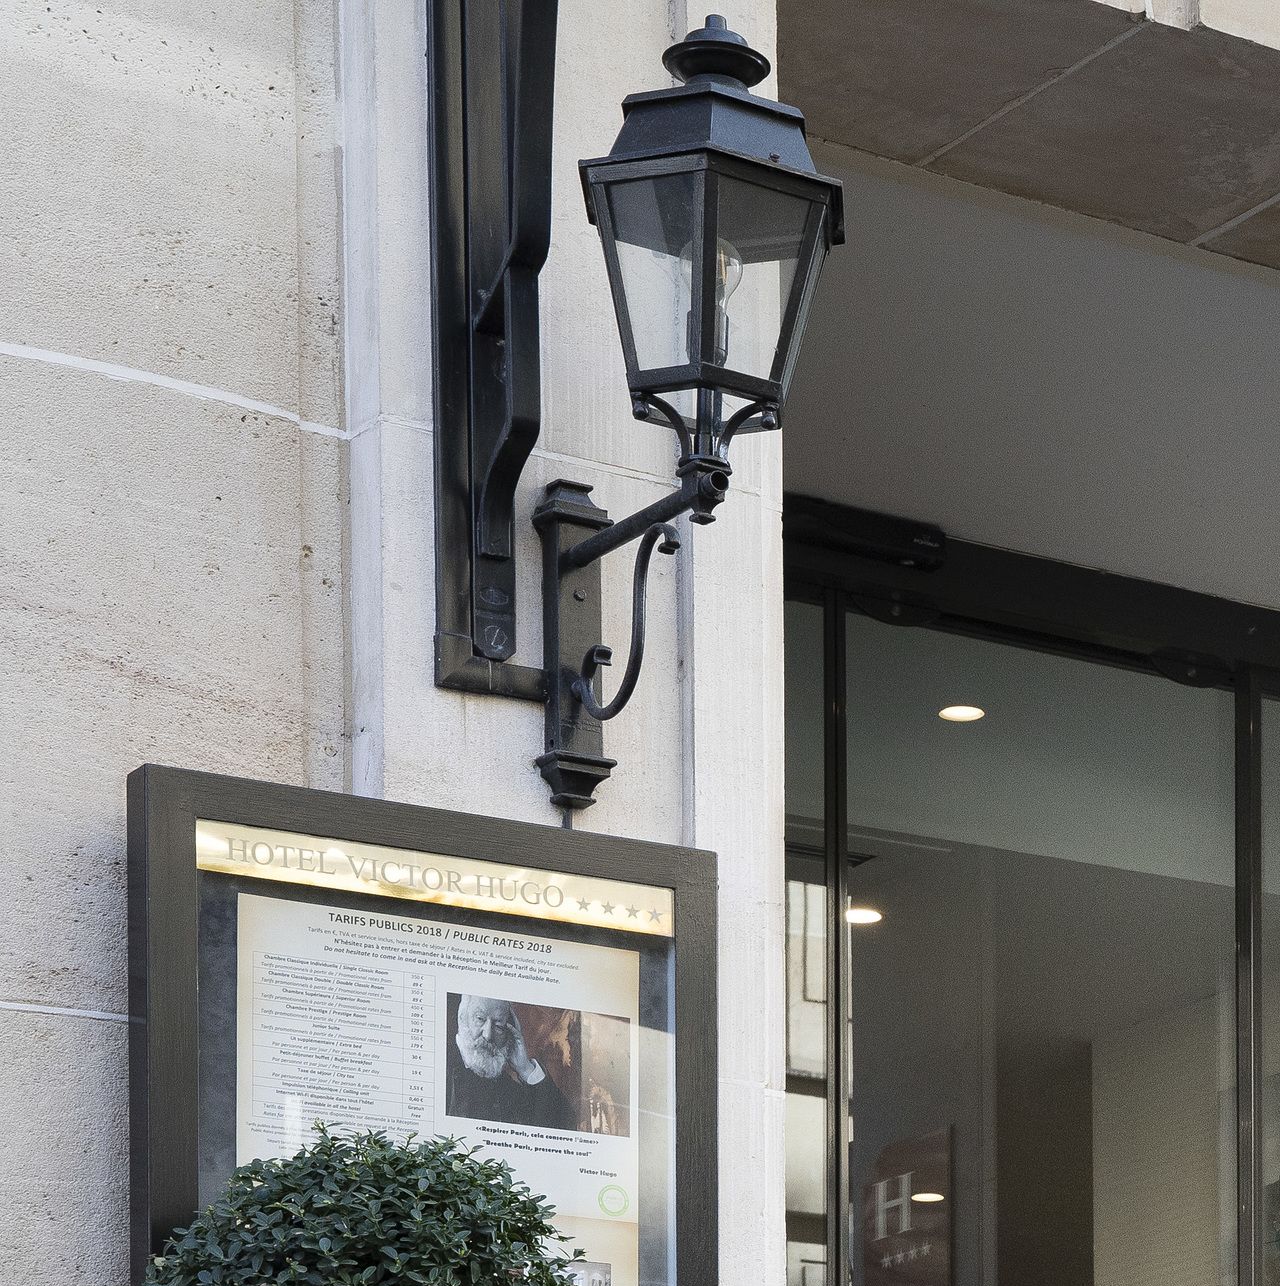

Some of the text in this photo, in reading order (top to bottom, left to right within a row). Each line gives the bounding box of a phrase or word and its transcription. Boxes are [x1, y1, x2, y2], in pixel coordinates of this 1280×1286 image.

[226, 837, 564, 909] HOTEL VICTOR HUGO
[329, 912, 365, 926] TARIFS
[369, 917, 412, 933] PUBLICS
[416, 924, 441, 937] 2018
[453, 930, 489, 944] PUBLIC
[492, 936, 524, 949] RATES
[526, 941, 552, 953] 2018
[263, 953, 285, 962] Chambre
[286, 957, 308, 965] Classique
[334, 946, 344, 954] not
[345, 948, 370, 958] hesitate
[372, 951, 378, 959] to
[379, 953, 396, 961] come
[404, 956, 416, 964] and
[417, 958, 427, 966] ask
[428, 959, 435, 967] at
[447, 962, 476, 972] Reception
[477, 966, 487, 974] the
[488, 968, 502, 976] daily
[504, 970, 516, 978] Best
[517, 972, 544, 982] Available
[545, 976, 560, 984] Rate.
[380, 944, 399, 953] entrer
[408, 948, 438, 958] demander
[452, 954, 481, 964] Réception
[489, 960, 513, 969] Meilleur
[515, 963, 528, 971] Tarif
[268, 970, 289, 978] Chambre
[290, 973, 312, 981] Classique
[314, 976, 331, 984] Double
[336, 979, 352, 987] Double
[282, 987, 303, 996] Chambre
[356, 997, 370, 1005] Room
[285, 1003, 306, 1011] Chambre
[530, 1131, 544, 1139] cela
[545, 1133, 573, 1142] conserve
[534, 1145, 561, 1154] preserve
[563, 1148, 574, 1156] the
[578, 1167, 598, 1176] Victor
